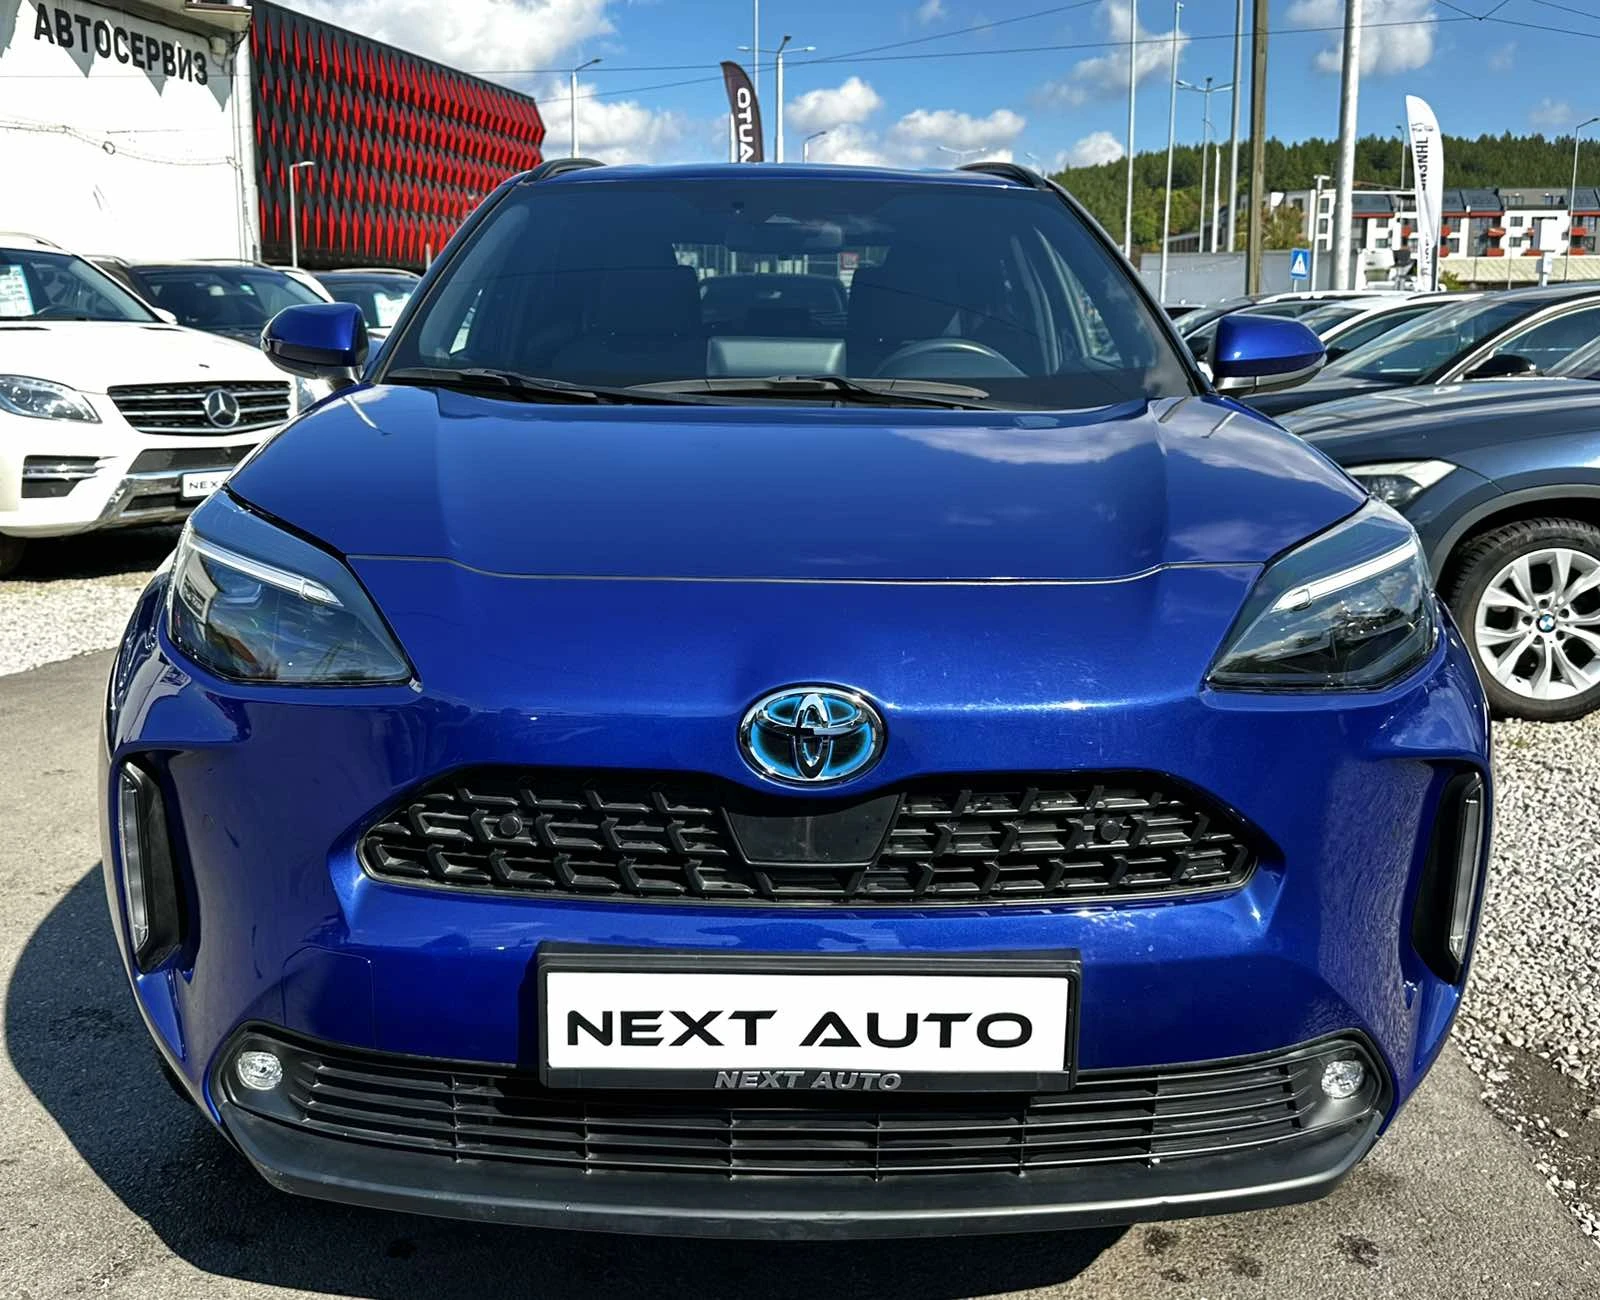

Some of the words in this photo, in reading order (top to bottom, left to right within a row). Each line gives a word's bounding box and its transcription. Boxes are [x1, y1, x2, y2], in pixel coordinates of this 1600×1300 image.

[34, 2, 208, 85] АВТОСЕРВИЗ
[189, 480, 223, 489] NEX
[567, 1010, 778, 1046] NEXT
[798, 1011, 1033, 1048] AUTO
[714, 1070, 806, 1089] NEXT
[810, 1071, 902, 1091] AUTO
